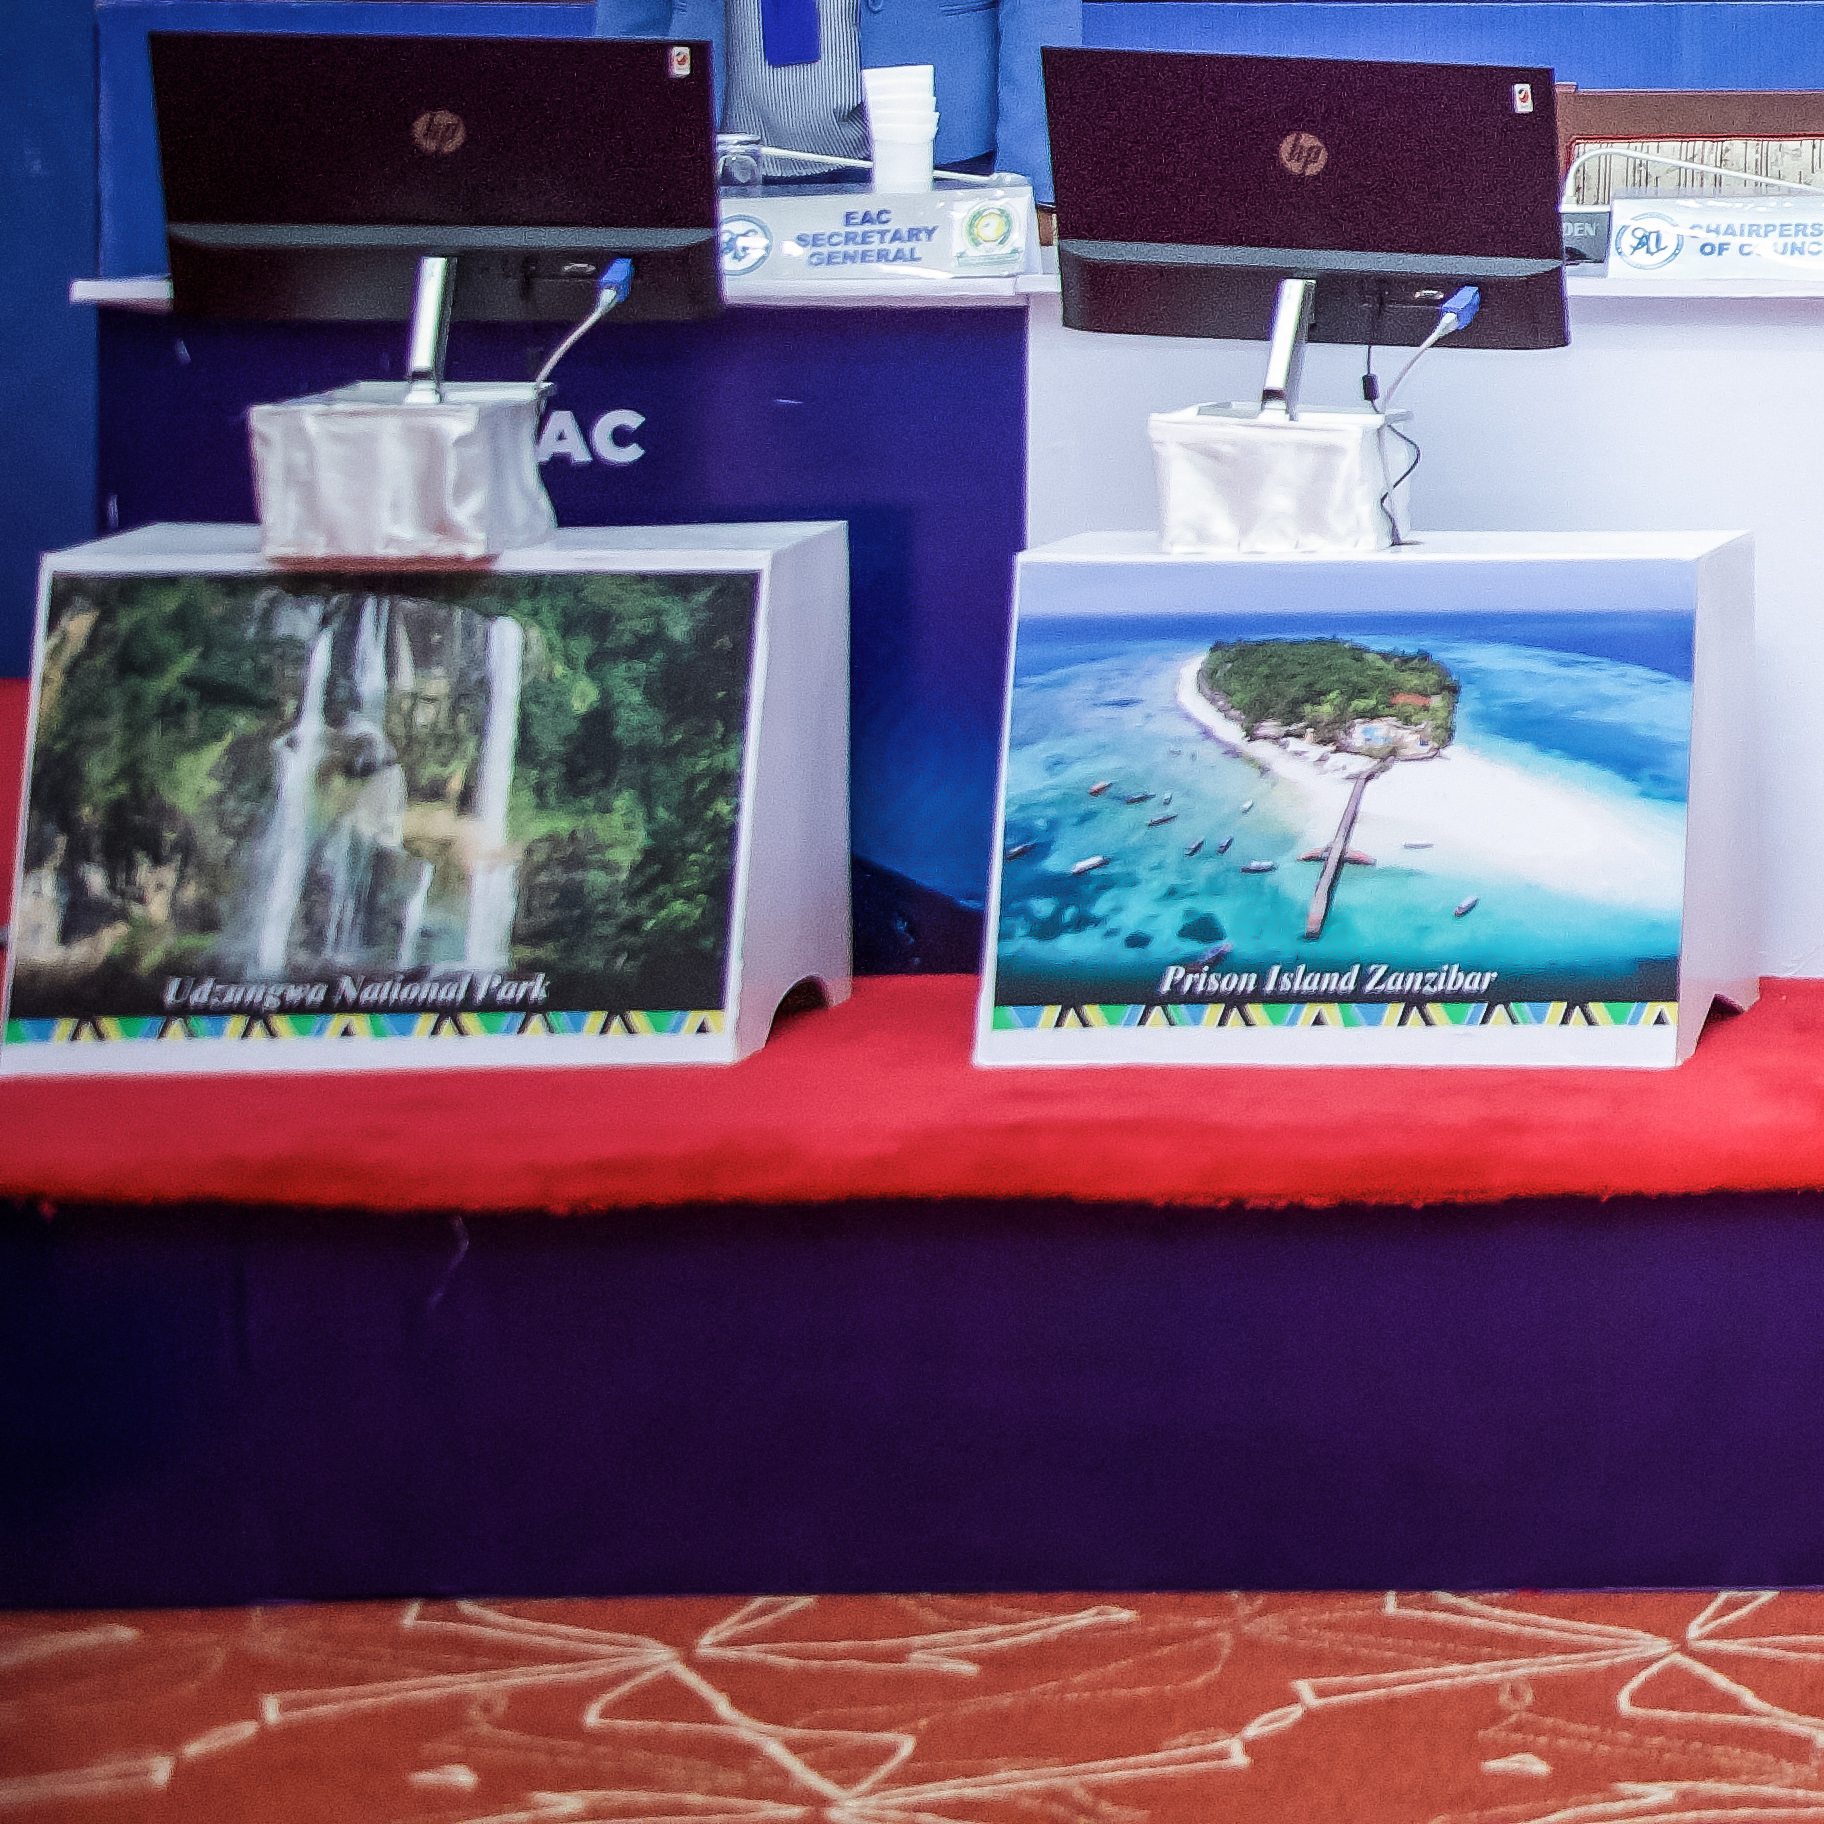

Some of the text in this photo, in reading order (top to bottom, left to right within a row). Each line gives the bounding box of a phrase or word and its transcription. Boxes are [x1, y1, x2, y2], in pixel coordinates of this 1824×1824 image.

[845, 209, 892, 227] EAC
[796, 225, 940, 248] SECRETARY
[808, 247, 923, 268] GENERAL
[1700, 241, 1731, 257] OF
[538, 409, 646, 465] AC
[1160, 963, 1499, 995] Prison Island Zanzibar
[166, 970, 552, 1012] Udzungwa National Park
